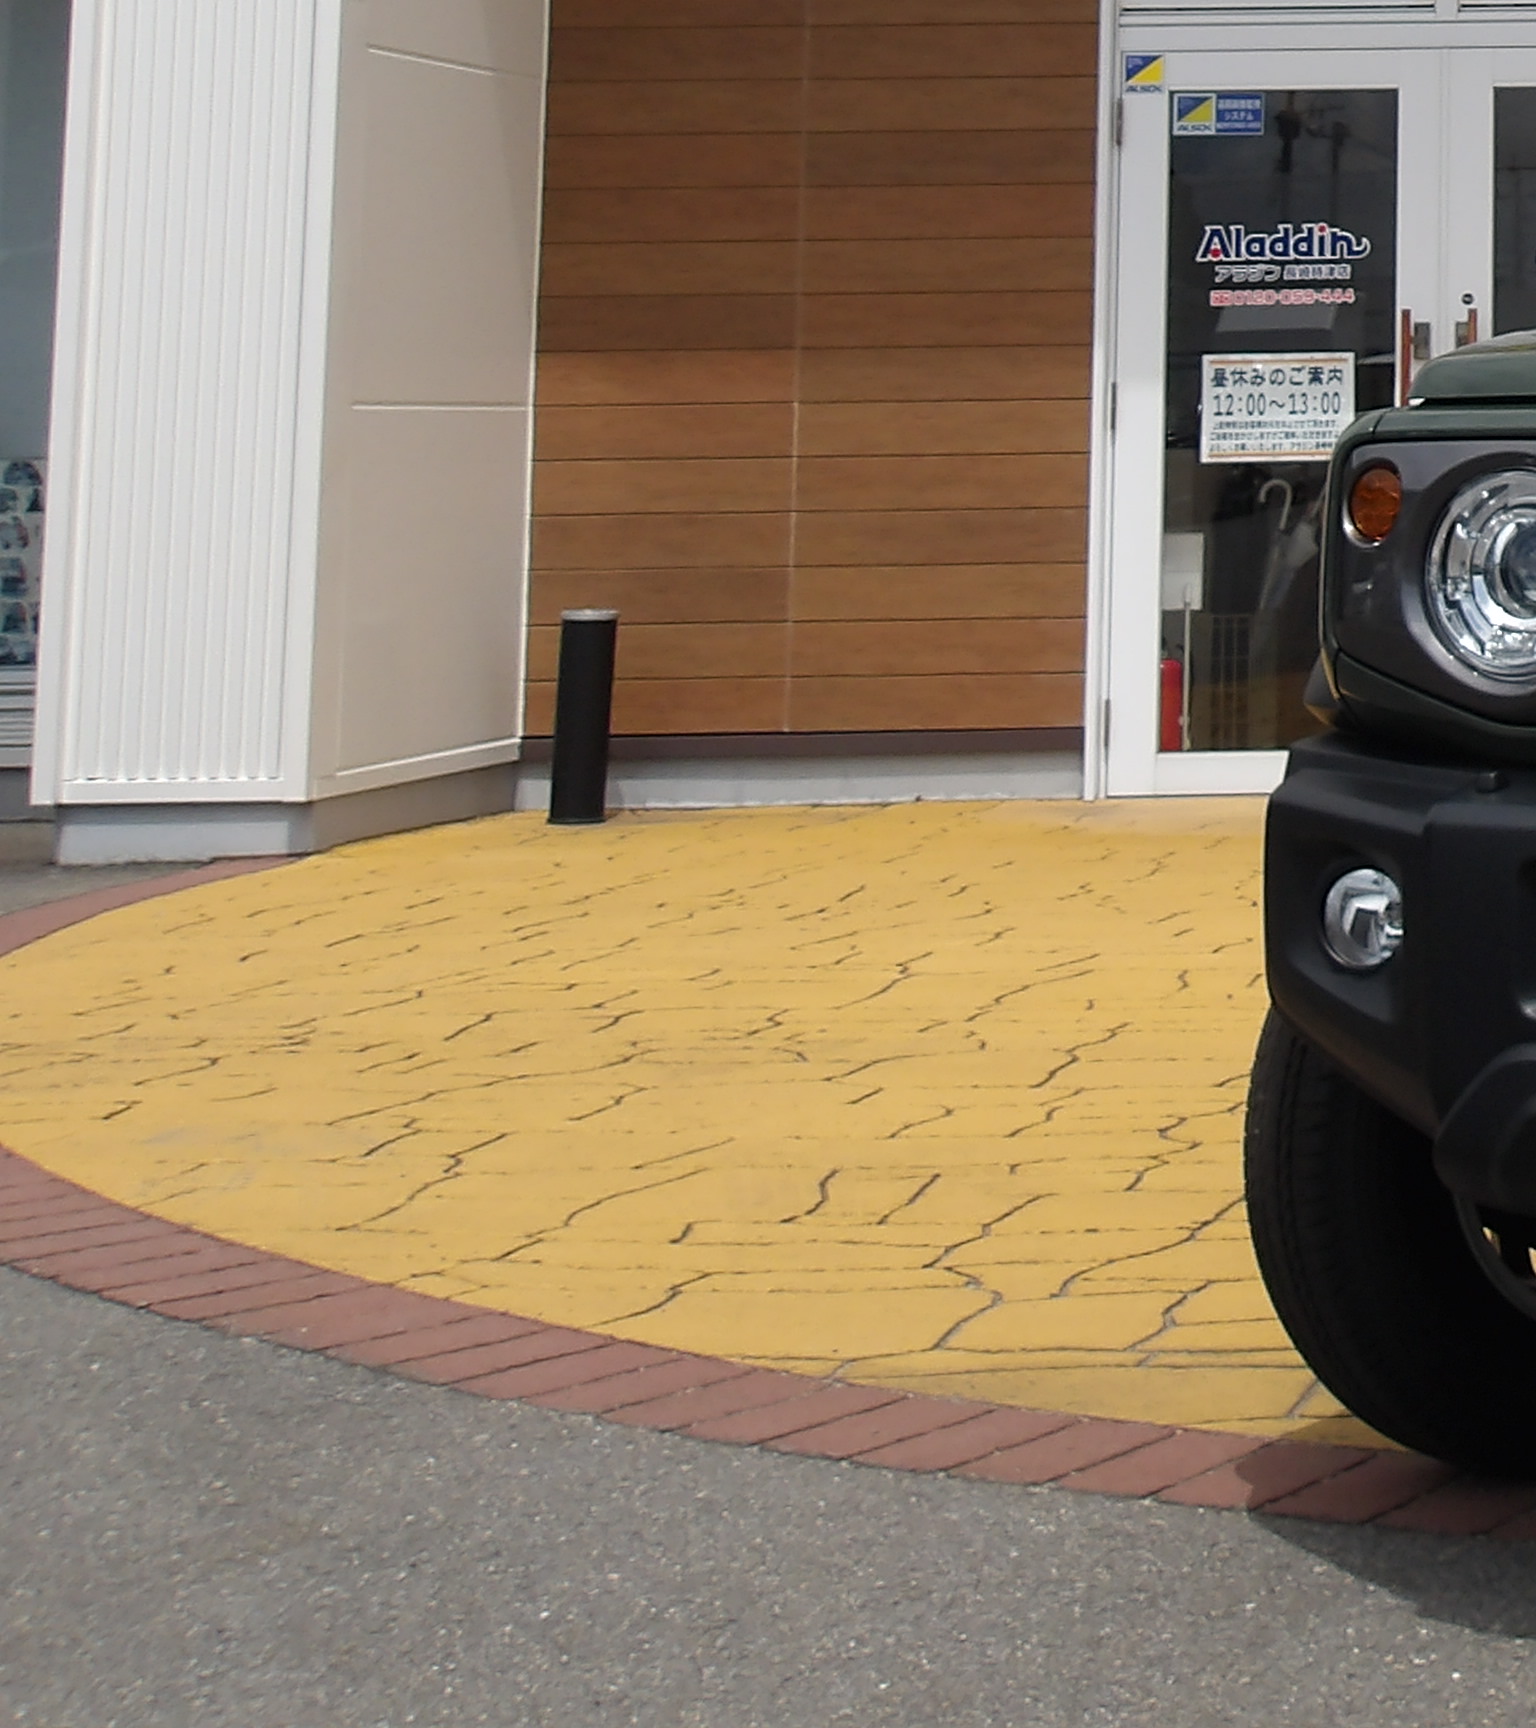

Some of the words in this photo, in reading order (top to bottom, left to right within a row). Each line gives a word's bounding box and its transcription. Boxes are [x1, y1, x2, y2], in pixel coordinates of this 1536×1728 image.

[1196, 223, 1371, 261] Aladdin
[1215, 263, 1281, 282] アラジン
[1211, 366, 1343, 388] 昼休みのご案内
